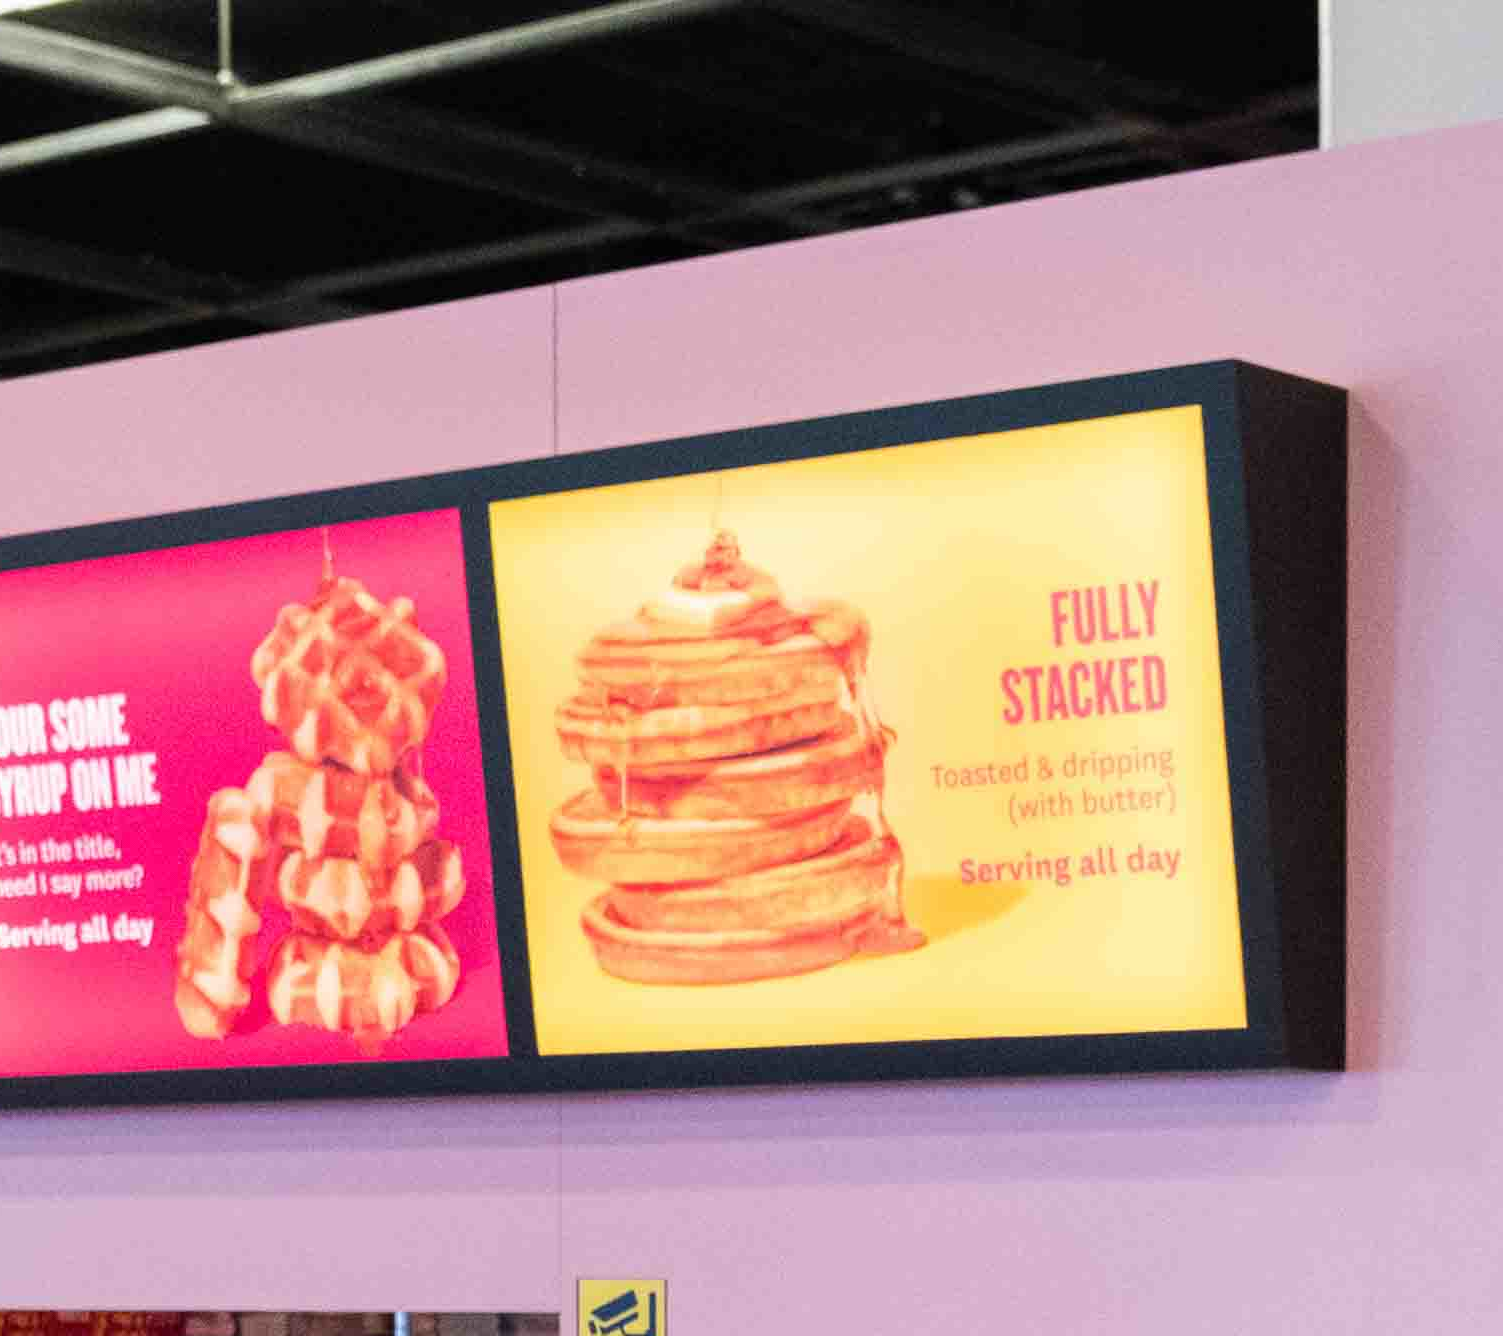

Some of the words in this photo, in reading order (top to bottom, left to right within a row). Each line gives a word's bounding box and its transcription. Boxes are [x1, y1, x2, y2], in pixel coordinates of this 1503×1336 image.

[1051, 579, 1158, 648] FULLY
[1000, 655, 1169, 725] STACKED
[49, 693, 130, 752] SOME
[70, 757, 114, 812] ON
[115, 752, 161, 807] ME
[930, 756, 1029, 788] Toasted
[1037, 755, 1054, 782] &
[1063, 747, 1174, 781] dripping
[1008, 791, 1073, 828] (with
[1082, 783, 1178, 817] butter)
[18, 840, 38, 865] in
[40, 838, 72, 863] the
[74, 832, 122, 862] title,
[960, 852, 1074, 888] Serving
[1079, 845, 1118, 877] all
[1127, 843, 1182, 880] day
[50, 873, 83, 899] say
[85, 864, 143, 892] more?
[80, 913, 111, 943] all
[113, 913, 154, 947] day
